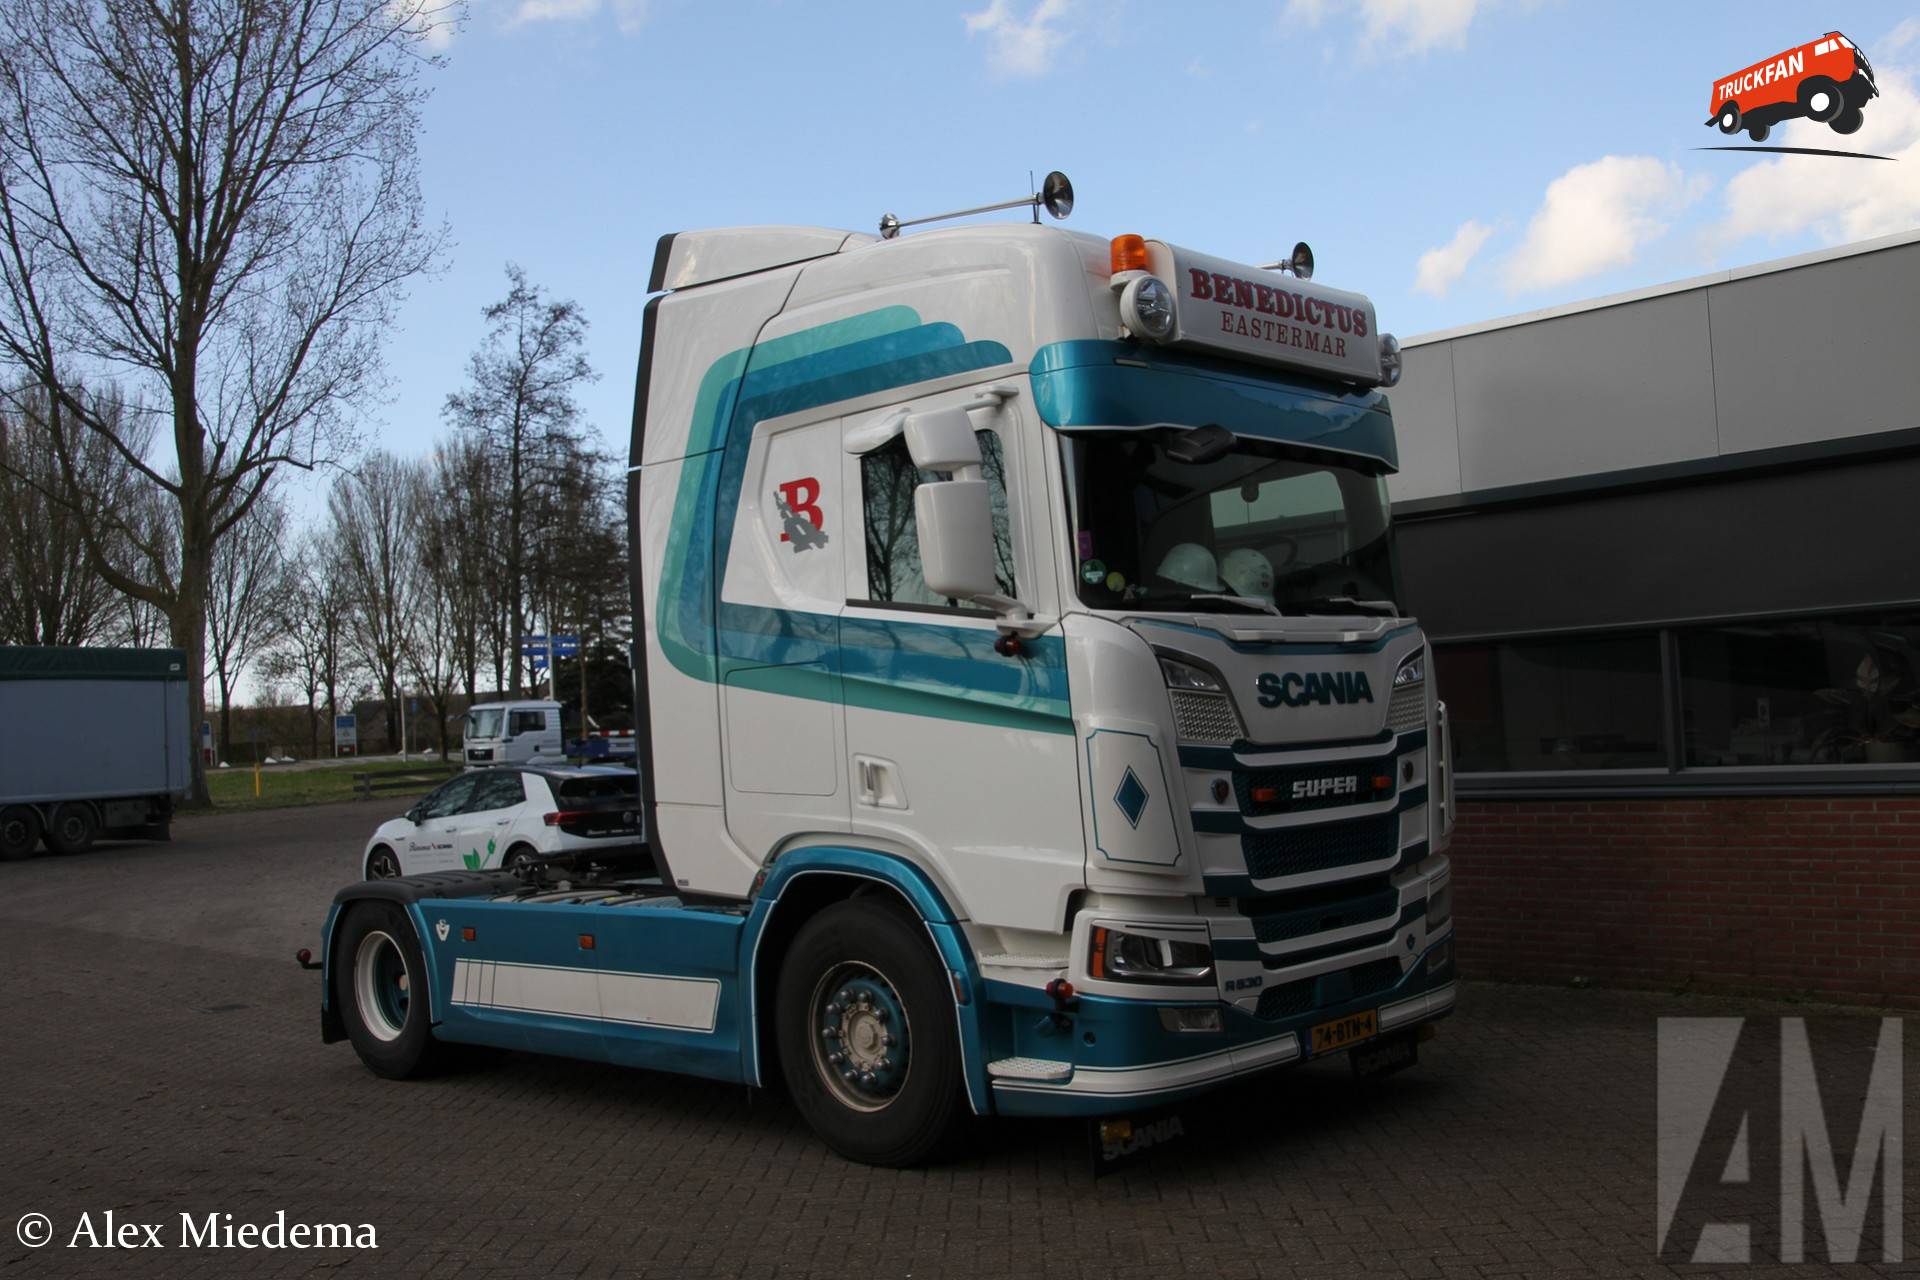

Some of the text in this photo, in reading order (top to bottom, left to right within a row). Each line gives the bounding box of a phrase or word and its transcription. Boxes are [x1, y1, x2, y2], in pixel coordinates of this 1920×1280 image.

[1188, 267, 1368, 338] BENEDICTUS
[1221, 311, 1346, 358] EASTERMAR
[1256, 671, 1374, 709] SCANIA
[1292, 775, 1357, 799] SUPER
